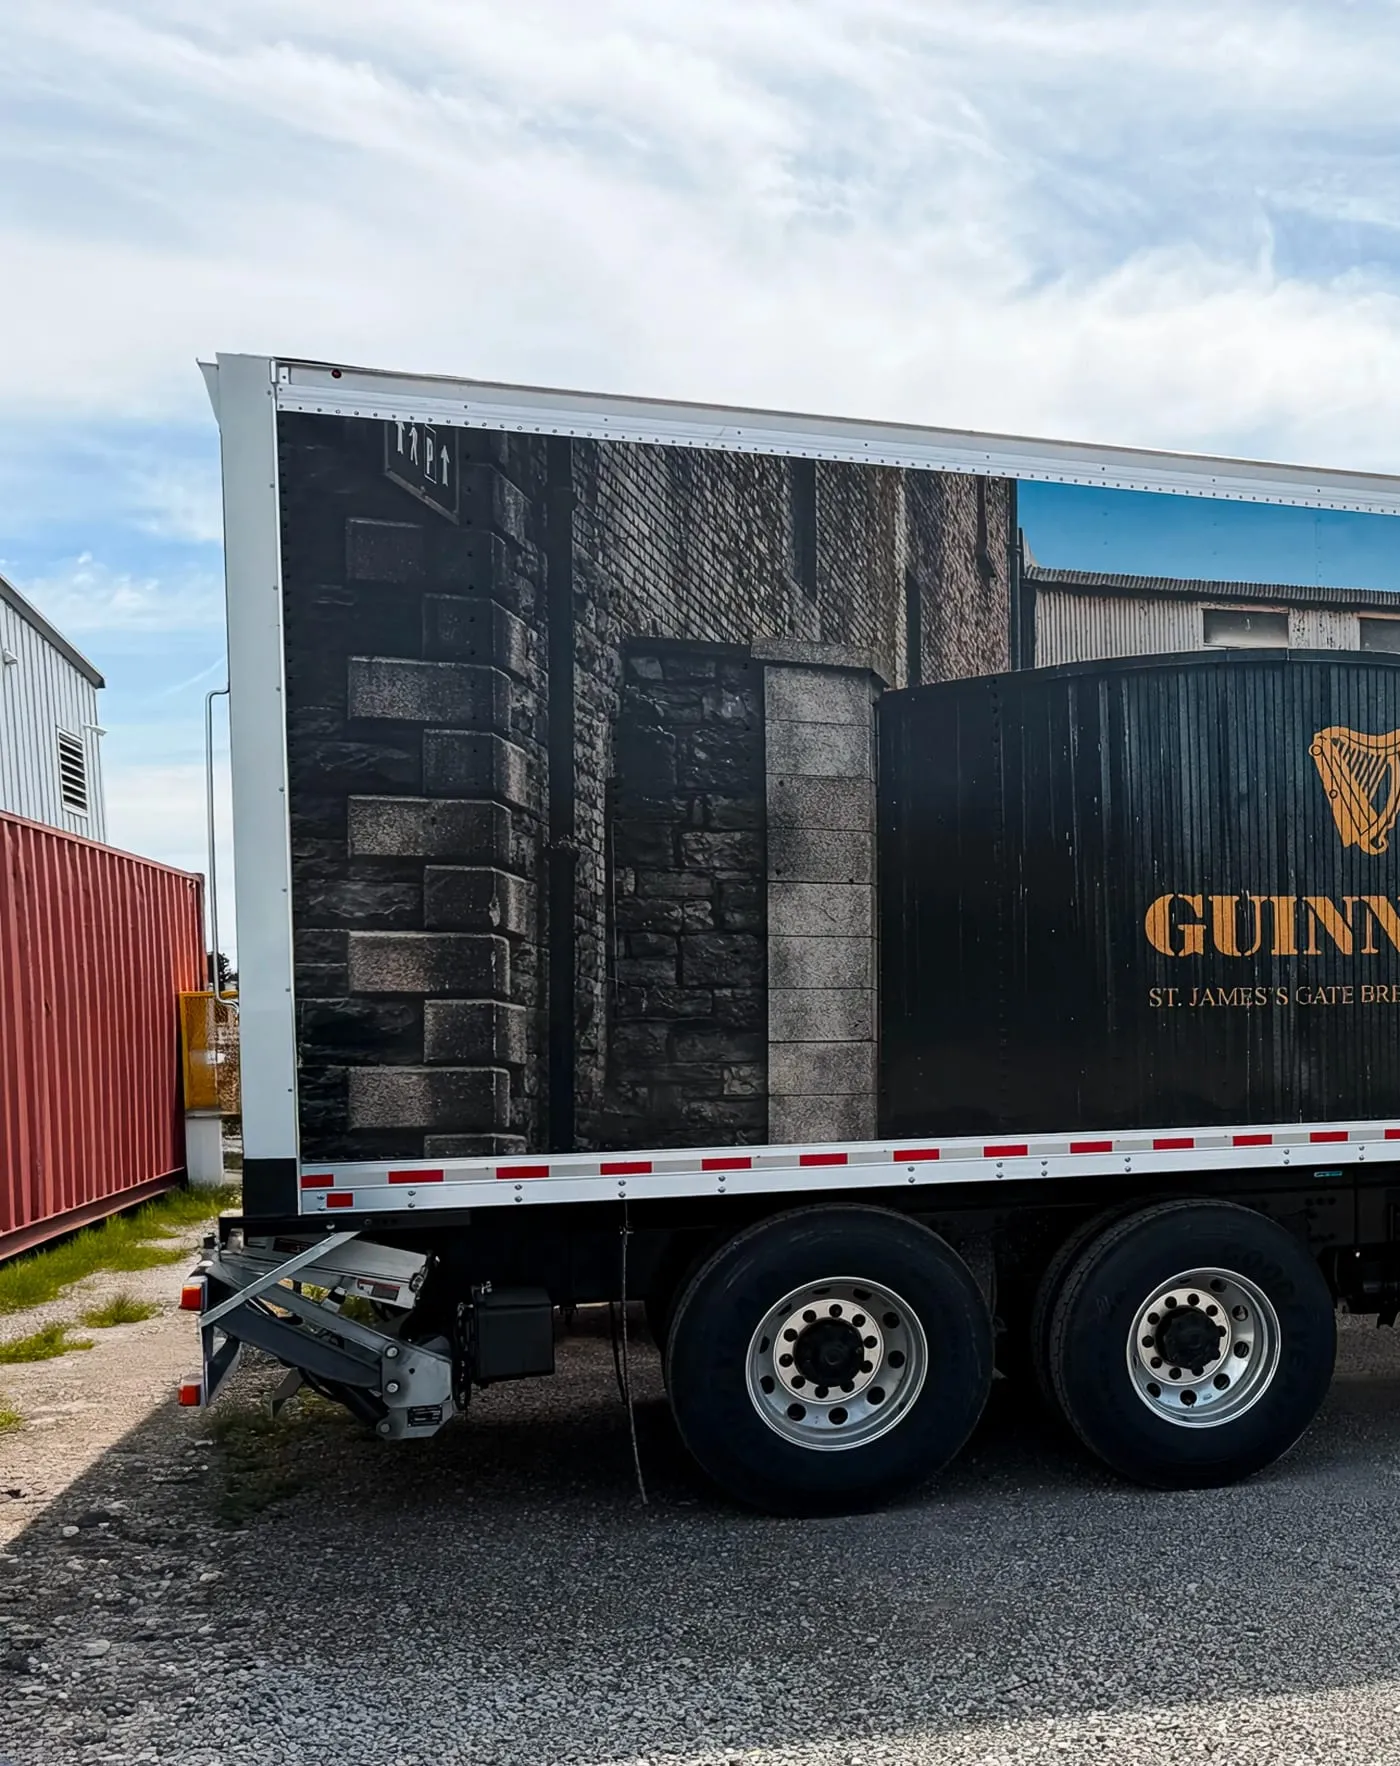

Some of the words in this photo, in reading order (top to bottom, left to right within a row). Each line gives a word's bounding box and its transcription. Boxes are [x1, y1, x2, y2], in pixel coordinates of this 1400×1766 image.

[1149, 987, 1183, 1008] ST.
[1189, 986, 1289, 1008] JAMES'S
[1295, 984, 1355, 1005] GATE
